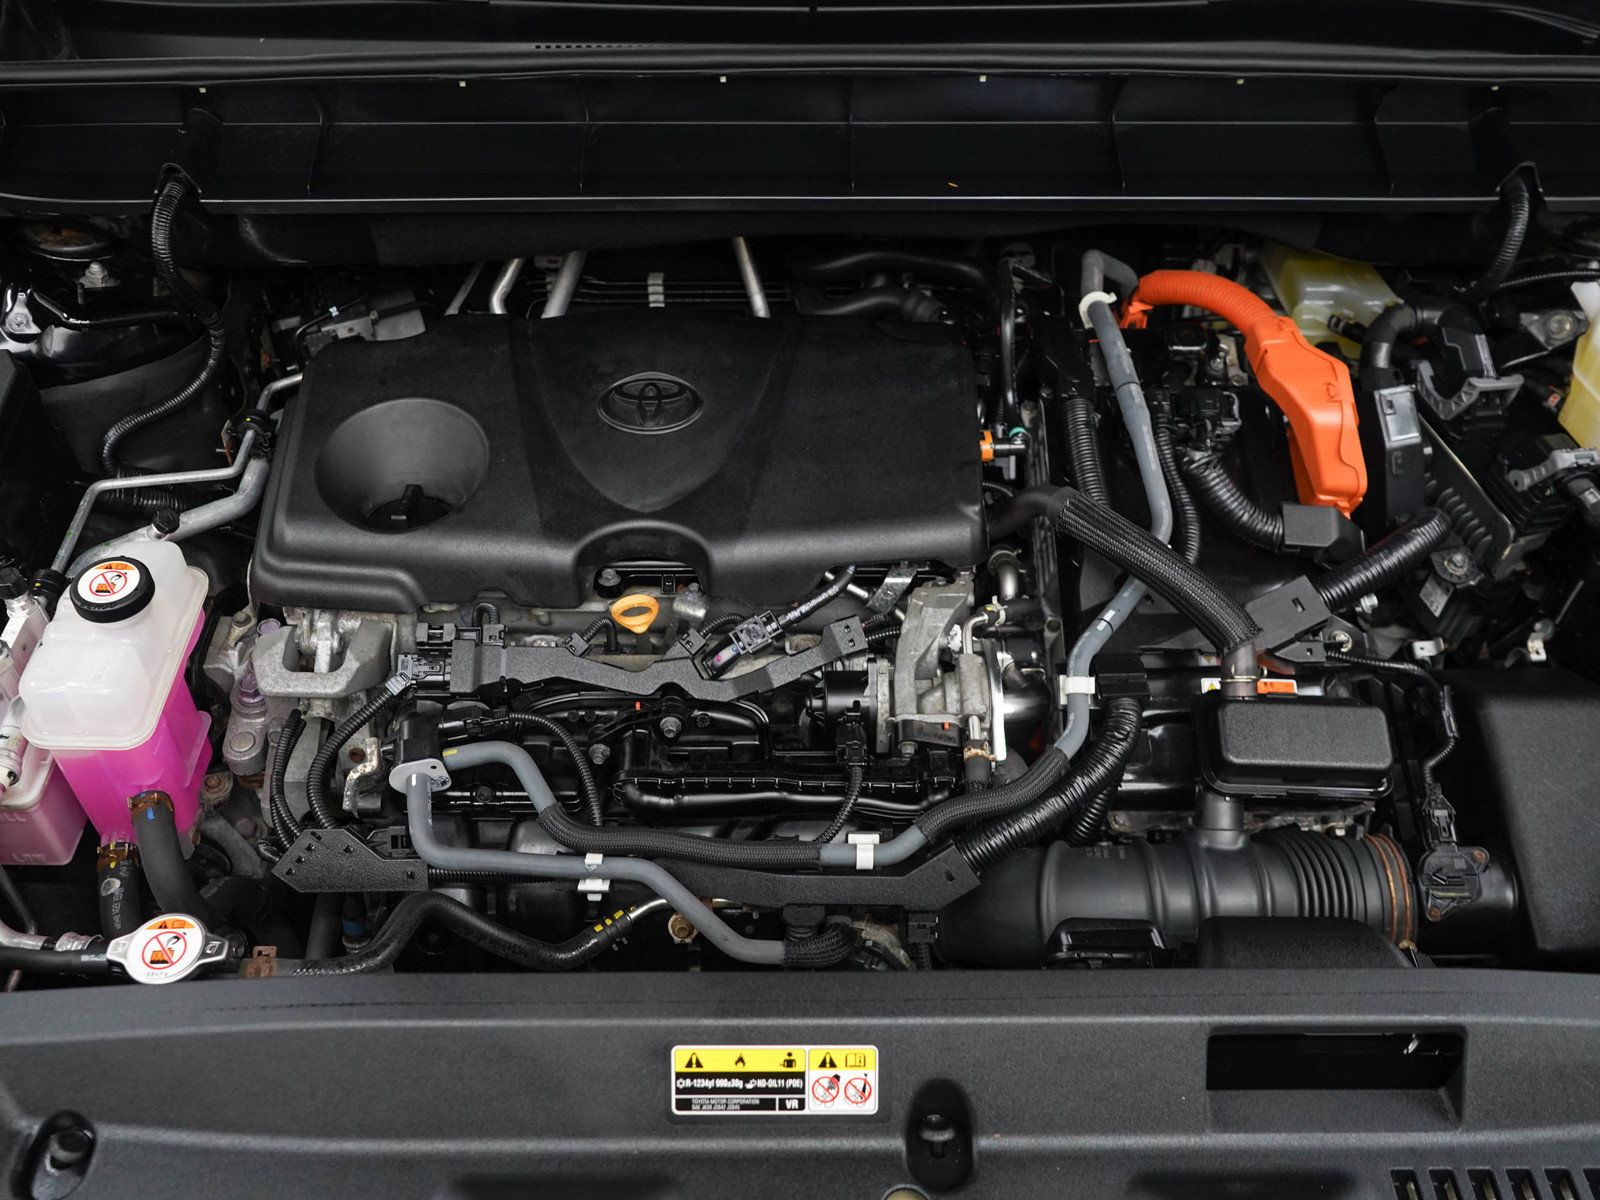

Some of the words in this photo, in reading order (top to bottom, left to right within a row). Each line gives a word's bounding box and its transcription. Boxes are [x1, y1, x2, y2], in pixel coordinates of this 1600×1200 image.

[685, 1078, 715, 1089] R-1234yf
[785, 1078, 803, 1089] (POE)
[785, 1099, 799, 1109] VR
